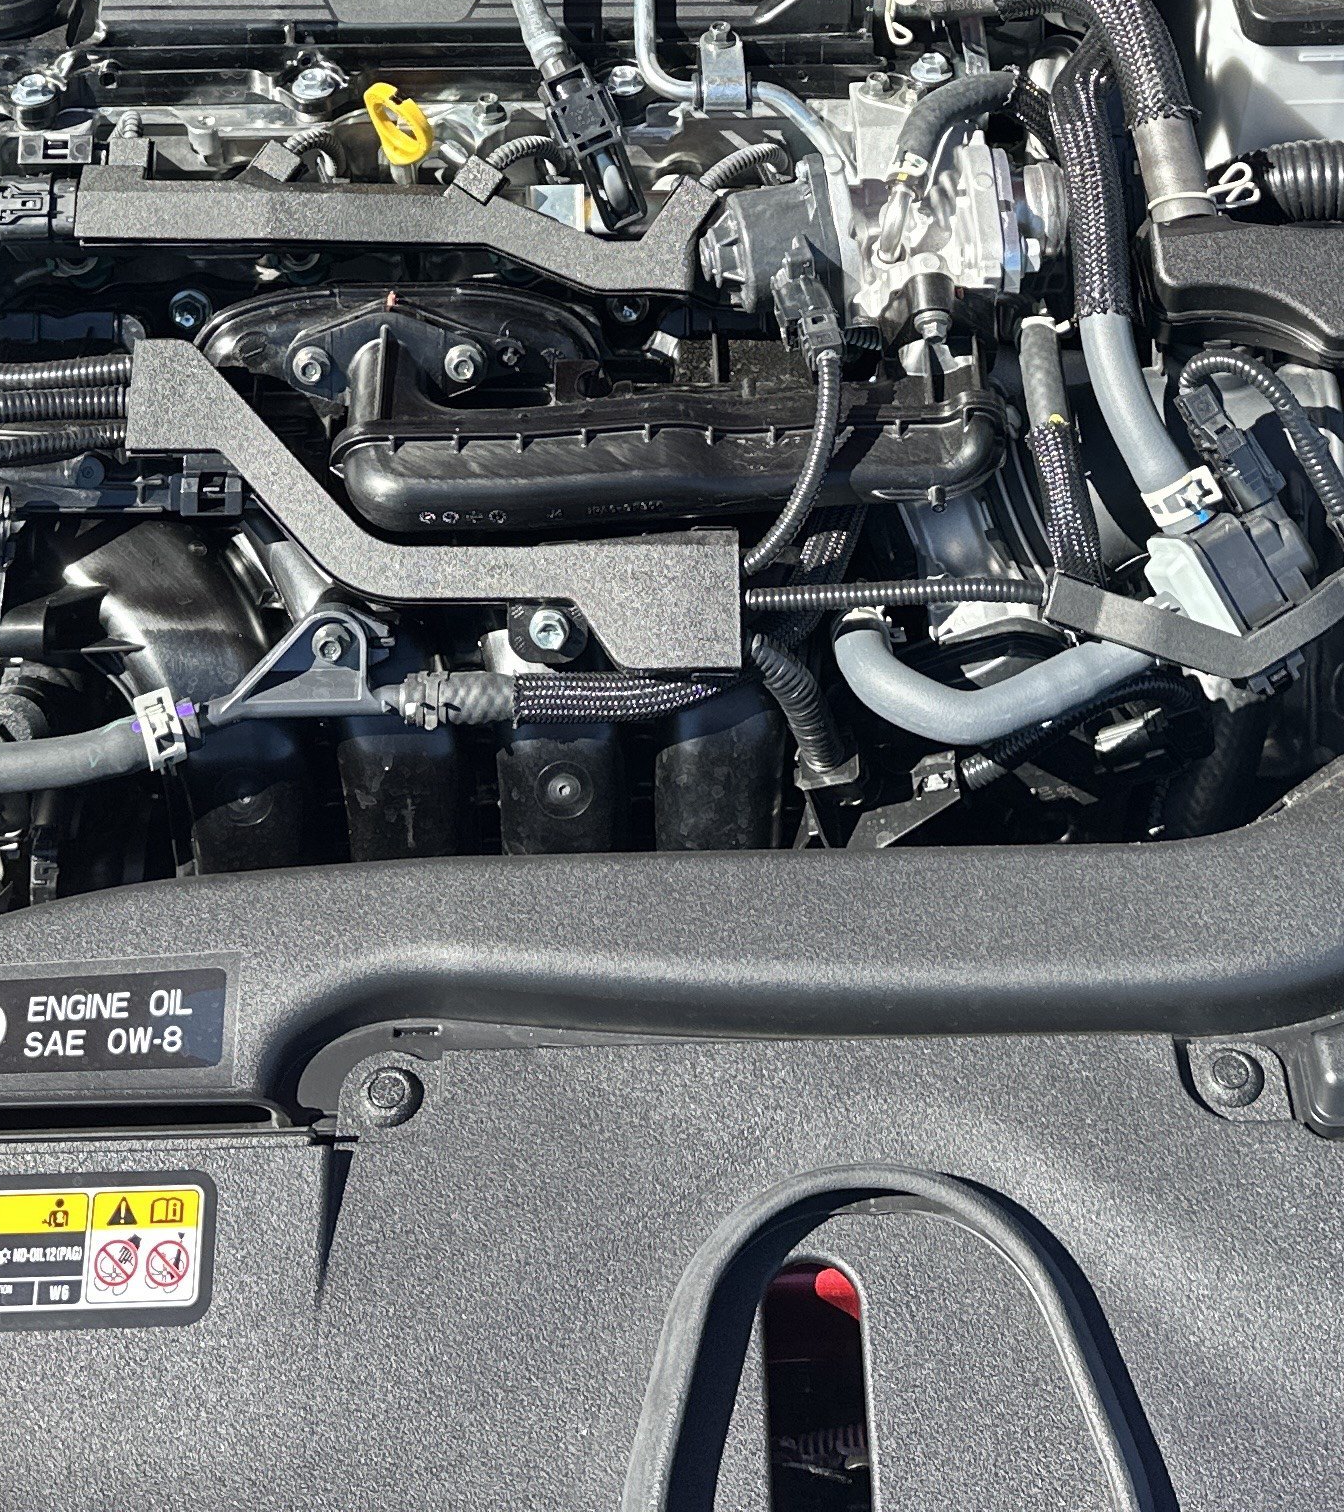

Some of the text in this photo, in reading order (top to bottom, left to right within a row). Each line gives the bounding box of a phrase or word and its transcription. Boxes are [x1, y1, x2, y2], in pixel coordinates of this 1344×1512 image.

[27, 988, 193, 1022] ENGINE OIL
[23, 1025, 183, 1058] SAE 0W-8
